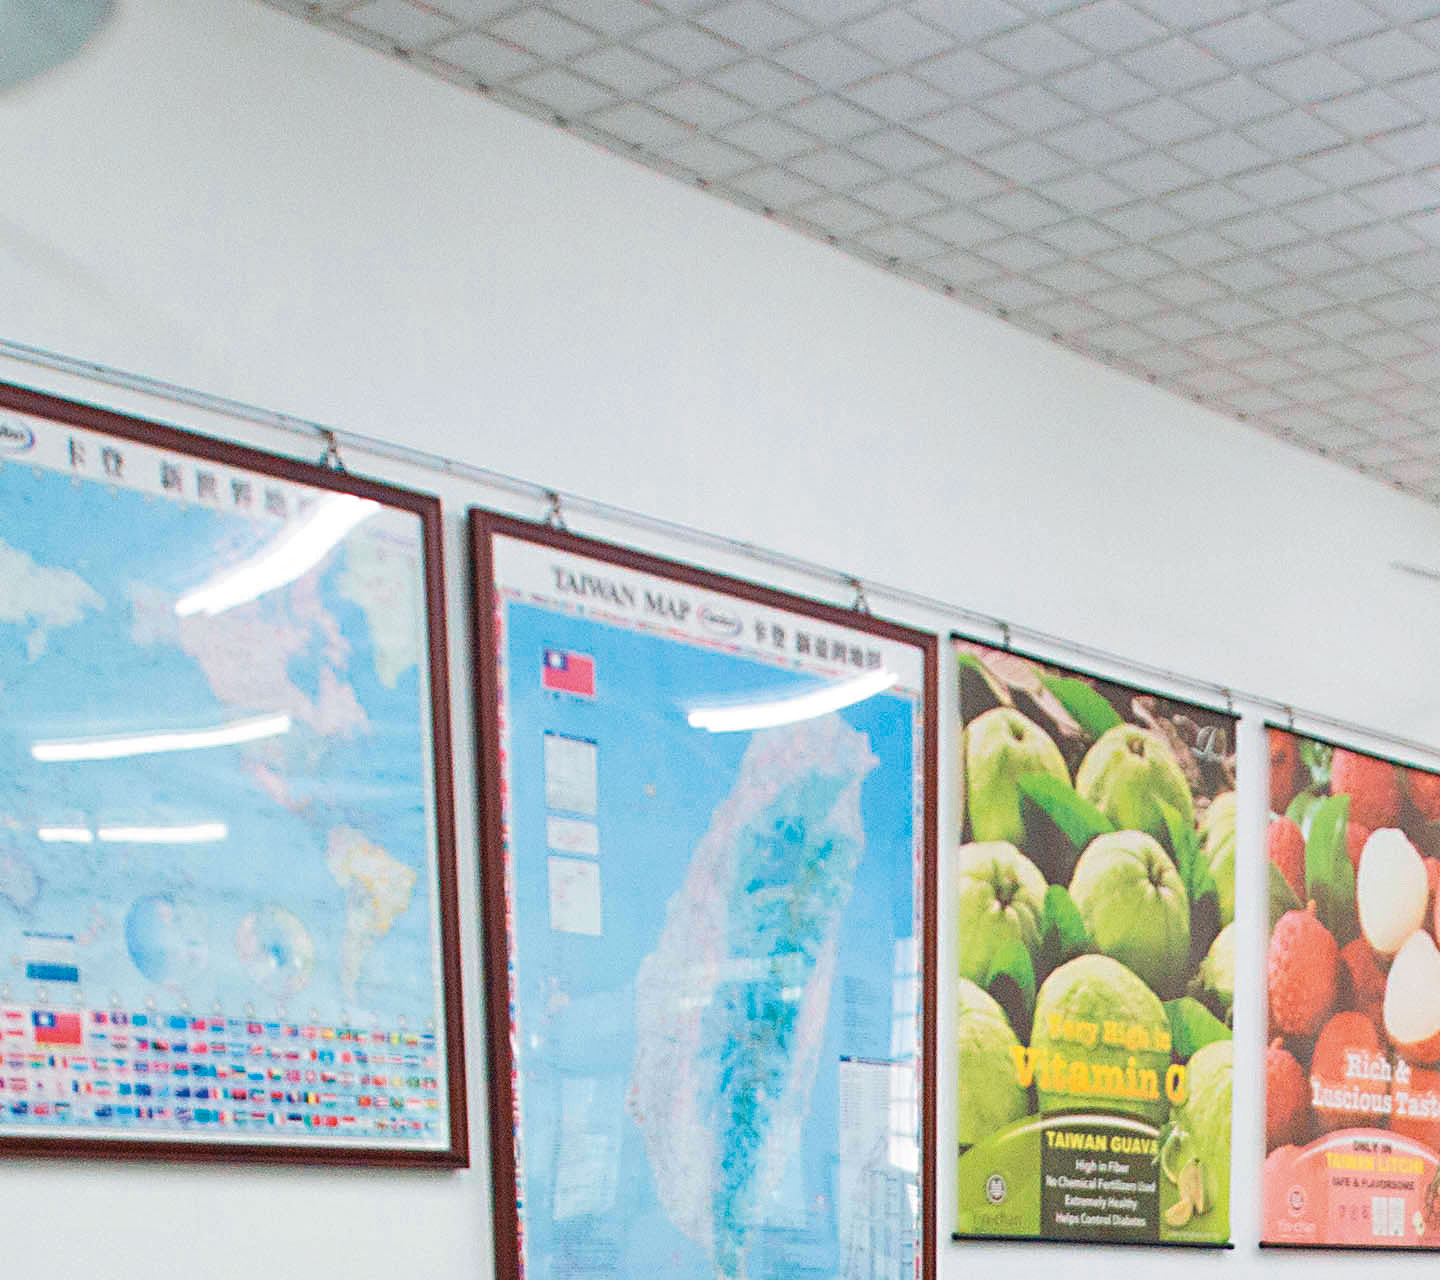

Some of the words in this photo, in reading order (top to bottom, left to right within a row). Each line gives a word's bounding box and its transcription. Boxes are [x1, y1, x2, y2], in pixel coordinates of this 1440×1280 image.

[552, 565, 635, 607] TAIWAN
[644, 591, 691, 621] MAP
[1046, 1013, 1098, 1045] Very
[1103, 1019, 1150, 1051] High
[1009, 1045, 1161, 1102] Vitamin
[1346, 1051, 1392, 1082] Rich
[1393, 1058, 1411, 1085] &
[1311, 1079, 1393, 1114] Luscious
[1045, 1130, 1108, 1152] TAIWAN
[1110, 1134, 1160, 1156] GUAVA
[1075, 1158, 1097, 1174] High
[1326, 1151, 1375, 1171] TAIWAN
[1058, 1175, 1097, 1191] Chemical
[1054, 1212, 1080, 1227] Helps
